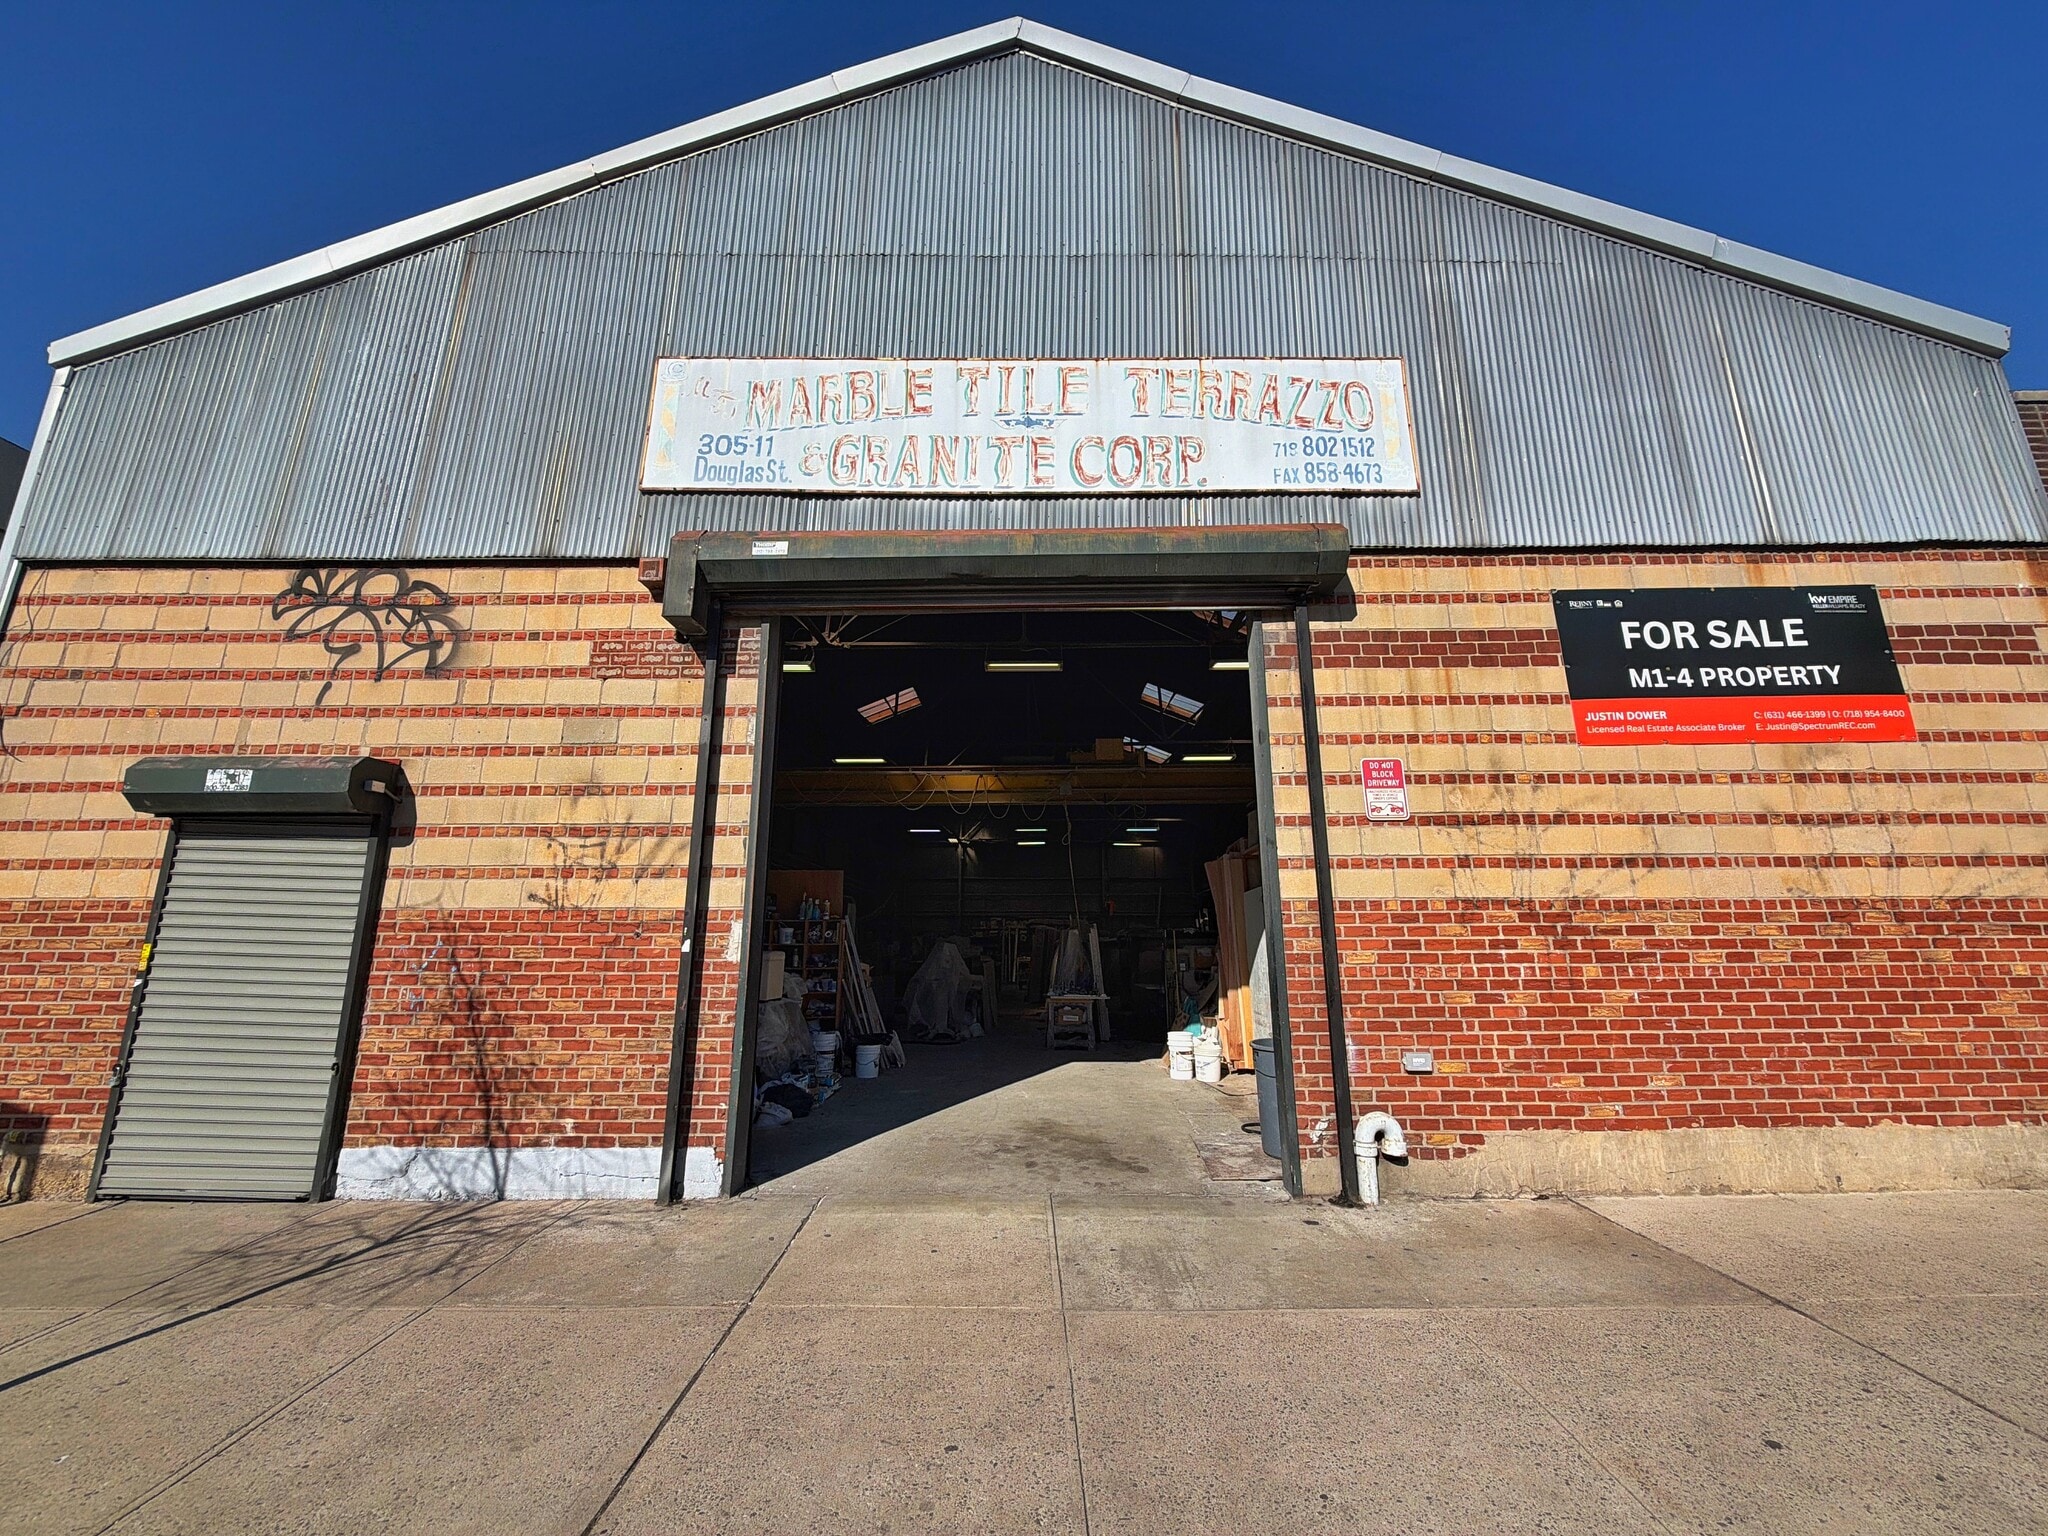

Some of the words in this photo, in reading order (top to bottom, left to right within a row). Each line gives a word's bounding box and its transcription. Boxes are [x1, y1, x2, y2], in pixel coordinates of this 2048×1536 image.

[743, 367, 934, 432] MARBLE
[957, 366, 1089, 417] TILE
[1124, 367, 1376, 432] TERRAZZO
[697, 433, 774, 457] 305-11
[1272, 442, 1298, 458] 718
[693, 455, 764, 486] Douglas
[766, 458, 793, 484] St.
[827, 434, 1056, 489] GRANITE
[1069, 434, 1208, 489] CORP.
[1273, 467, 1301, 485] FAX
[1620, 620, 1700, 650] FOR
[1706, 618, 1809, 649] SALE
[1629, 667, 1694, 689] M1-4
[1701, 664, 1841, 687] PROPERTY
[1585, 712, 1624, 721] JUSTIN
[1626, 711, 1667, 720] DOWER
[1753, 711, 1762, 719] C:
[1763, 710, 1785, 719] (631)
[1786, 710, 1826, 719] 466-1399
[1832, 710, 1841, 718] O:
[1843, 709, 1863, 718] (718)
[1586, 725, 1625, 733] Licensed
[1626, 725, 1645, 733] Real
[1647, 724, 1674, 732] Estate
[1675, 723, 1717, 732] Associate
[1717, 722, 1746, 731] Broker
[1755, 723, 1764, 731] E:
[1765, 721, 1876, 732] Justin@SpectrumREC.com
[1380, 761, 1394, 769] NOT
